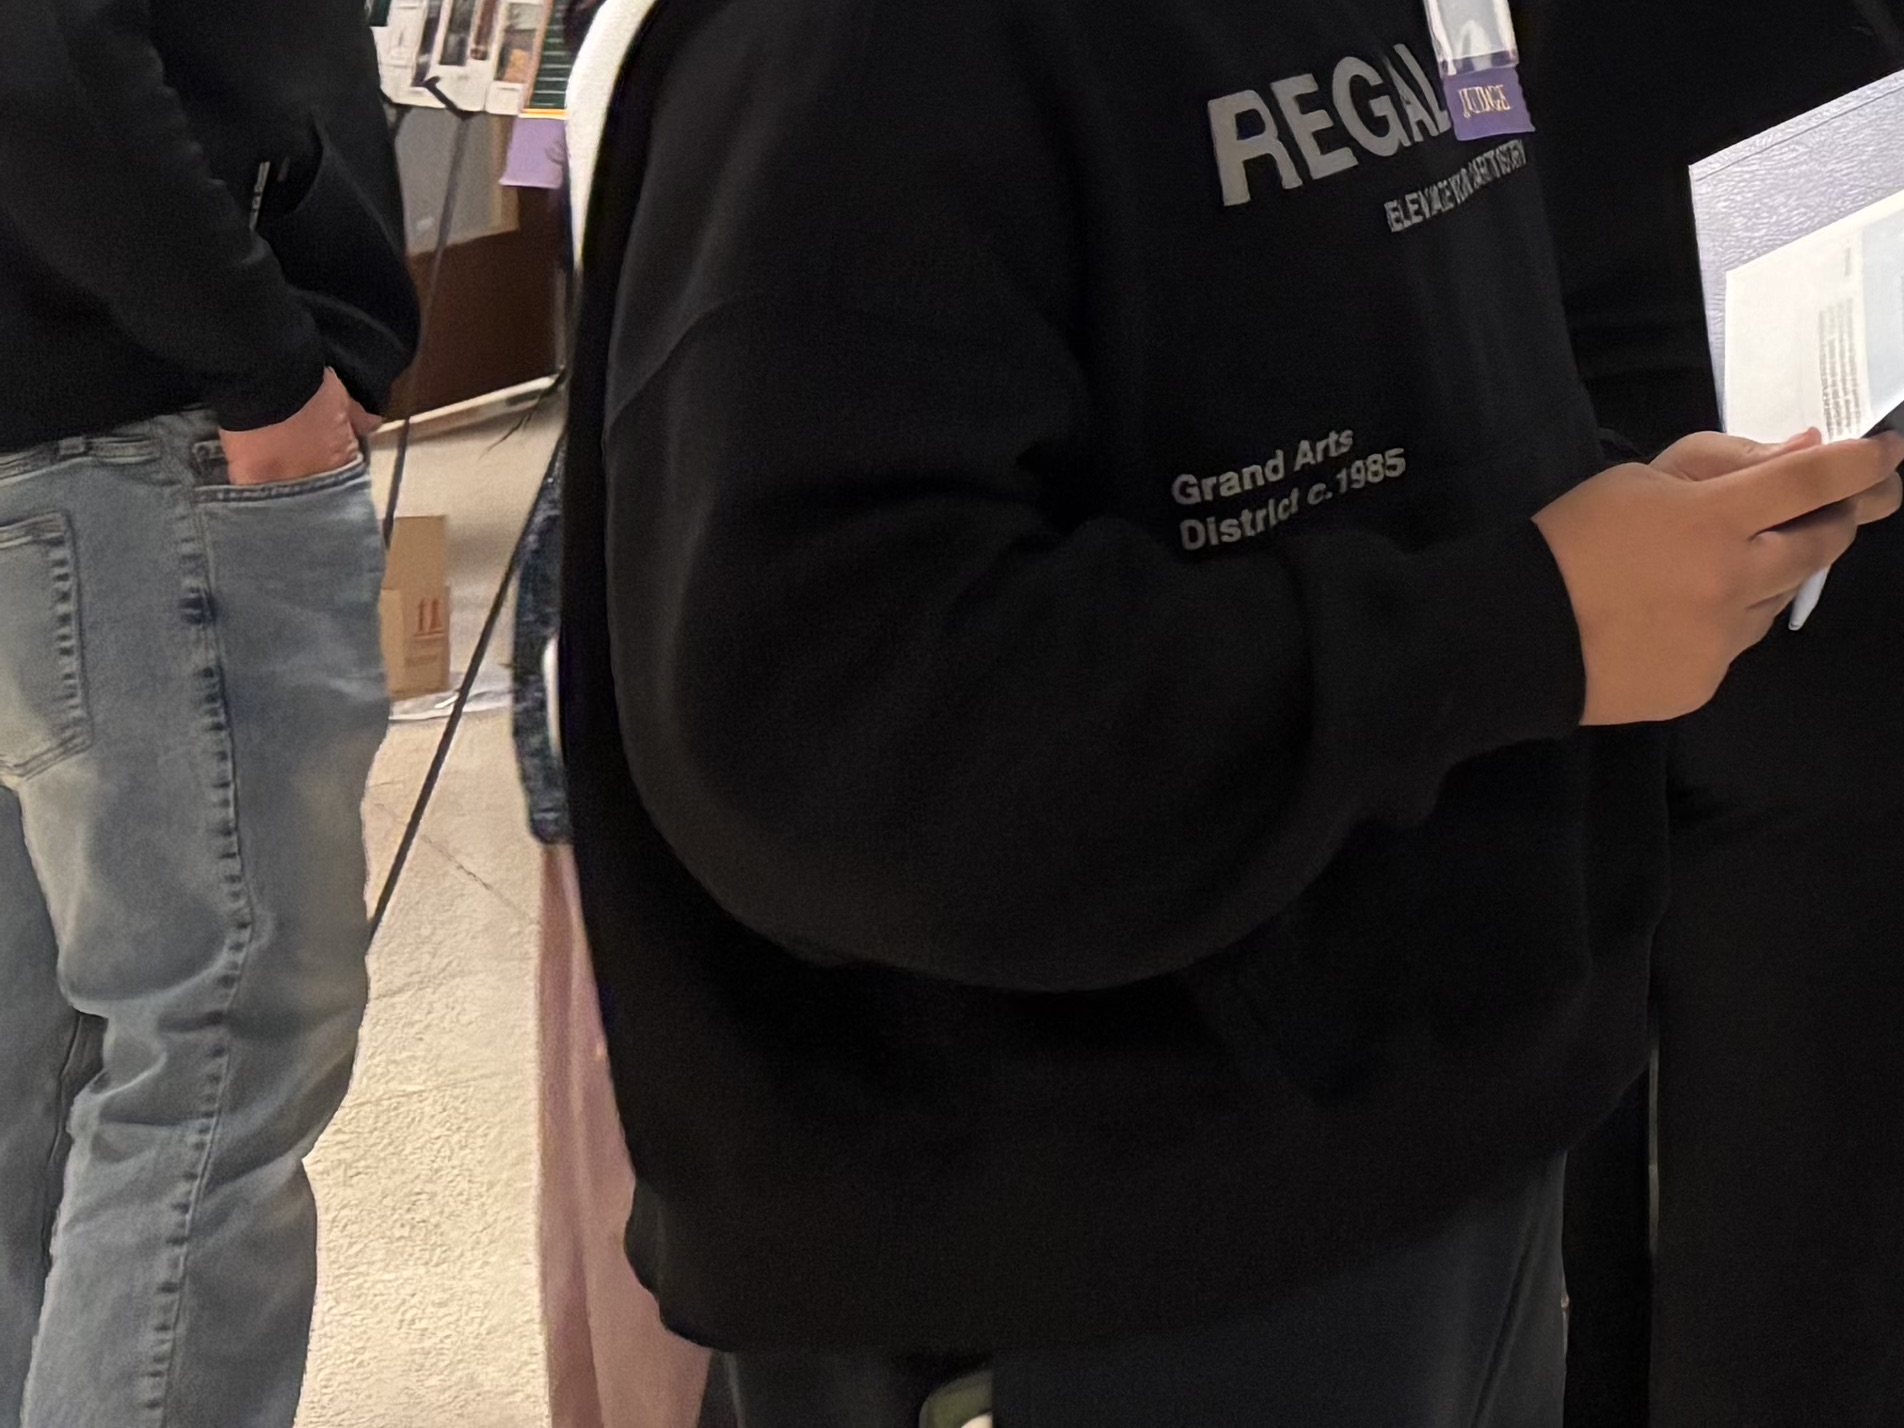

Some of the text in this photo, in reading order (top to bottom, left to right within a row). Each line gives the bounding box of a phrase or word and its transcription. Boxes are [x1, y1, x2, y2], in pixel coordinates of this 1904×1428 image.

[1208, 44, 1448, 206] REGAL
[1458, 85, 1513, 118] JUDGE
[1172, 426, 1353, 506] Grand Arts
[1179, 485, 1299, 552] District
